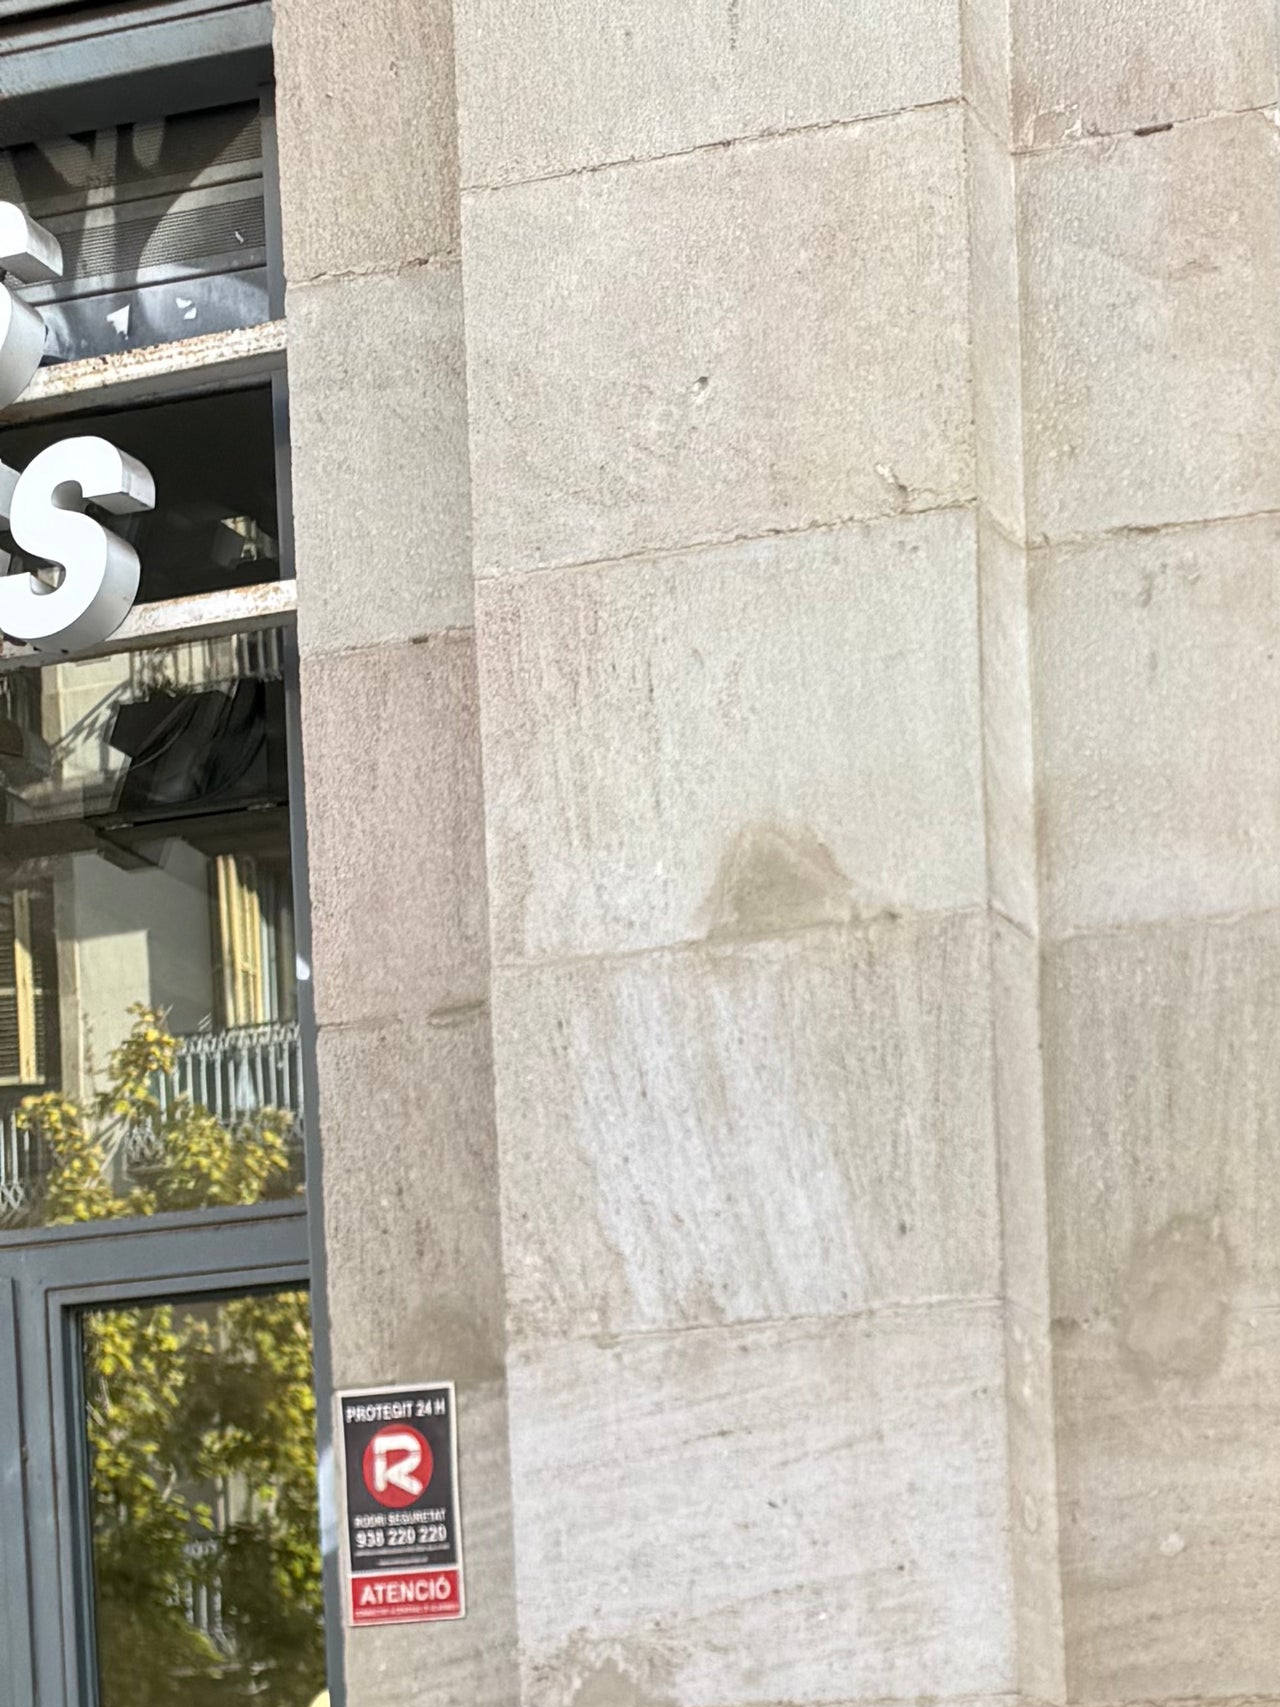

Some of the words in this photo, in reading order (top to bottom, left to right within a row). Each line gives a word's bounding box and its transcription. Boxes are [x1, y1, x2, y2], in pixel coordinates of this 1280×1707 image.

[416, 1399, 433, 1417] 24
[373, 1432, 424, 1496] R
[387, 1525, 416, 1547] 220
[418, 1523, 447, 1544] 220
[360, 1575, 452, 1607] ATENCIÓ
